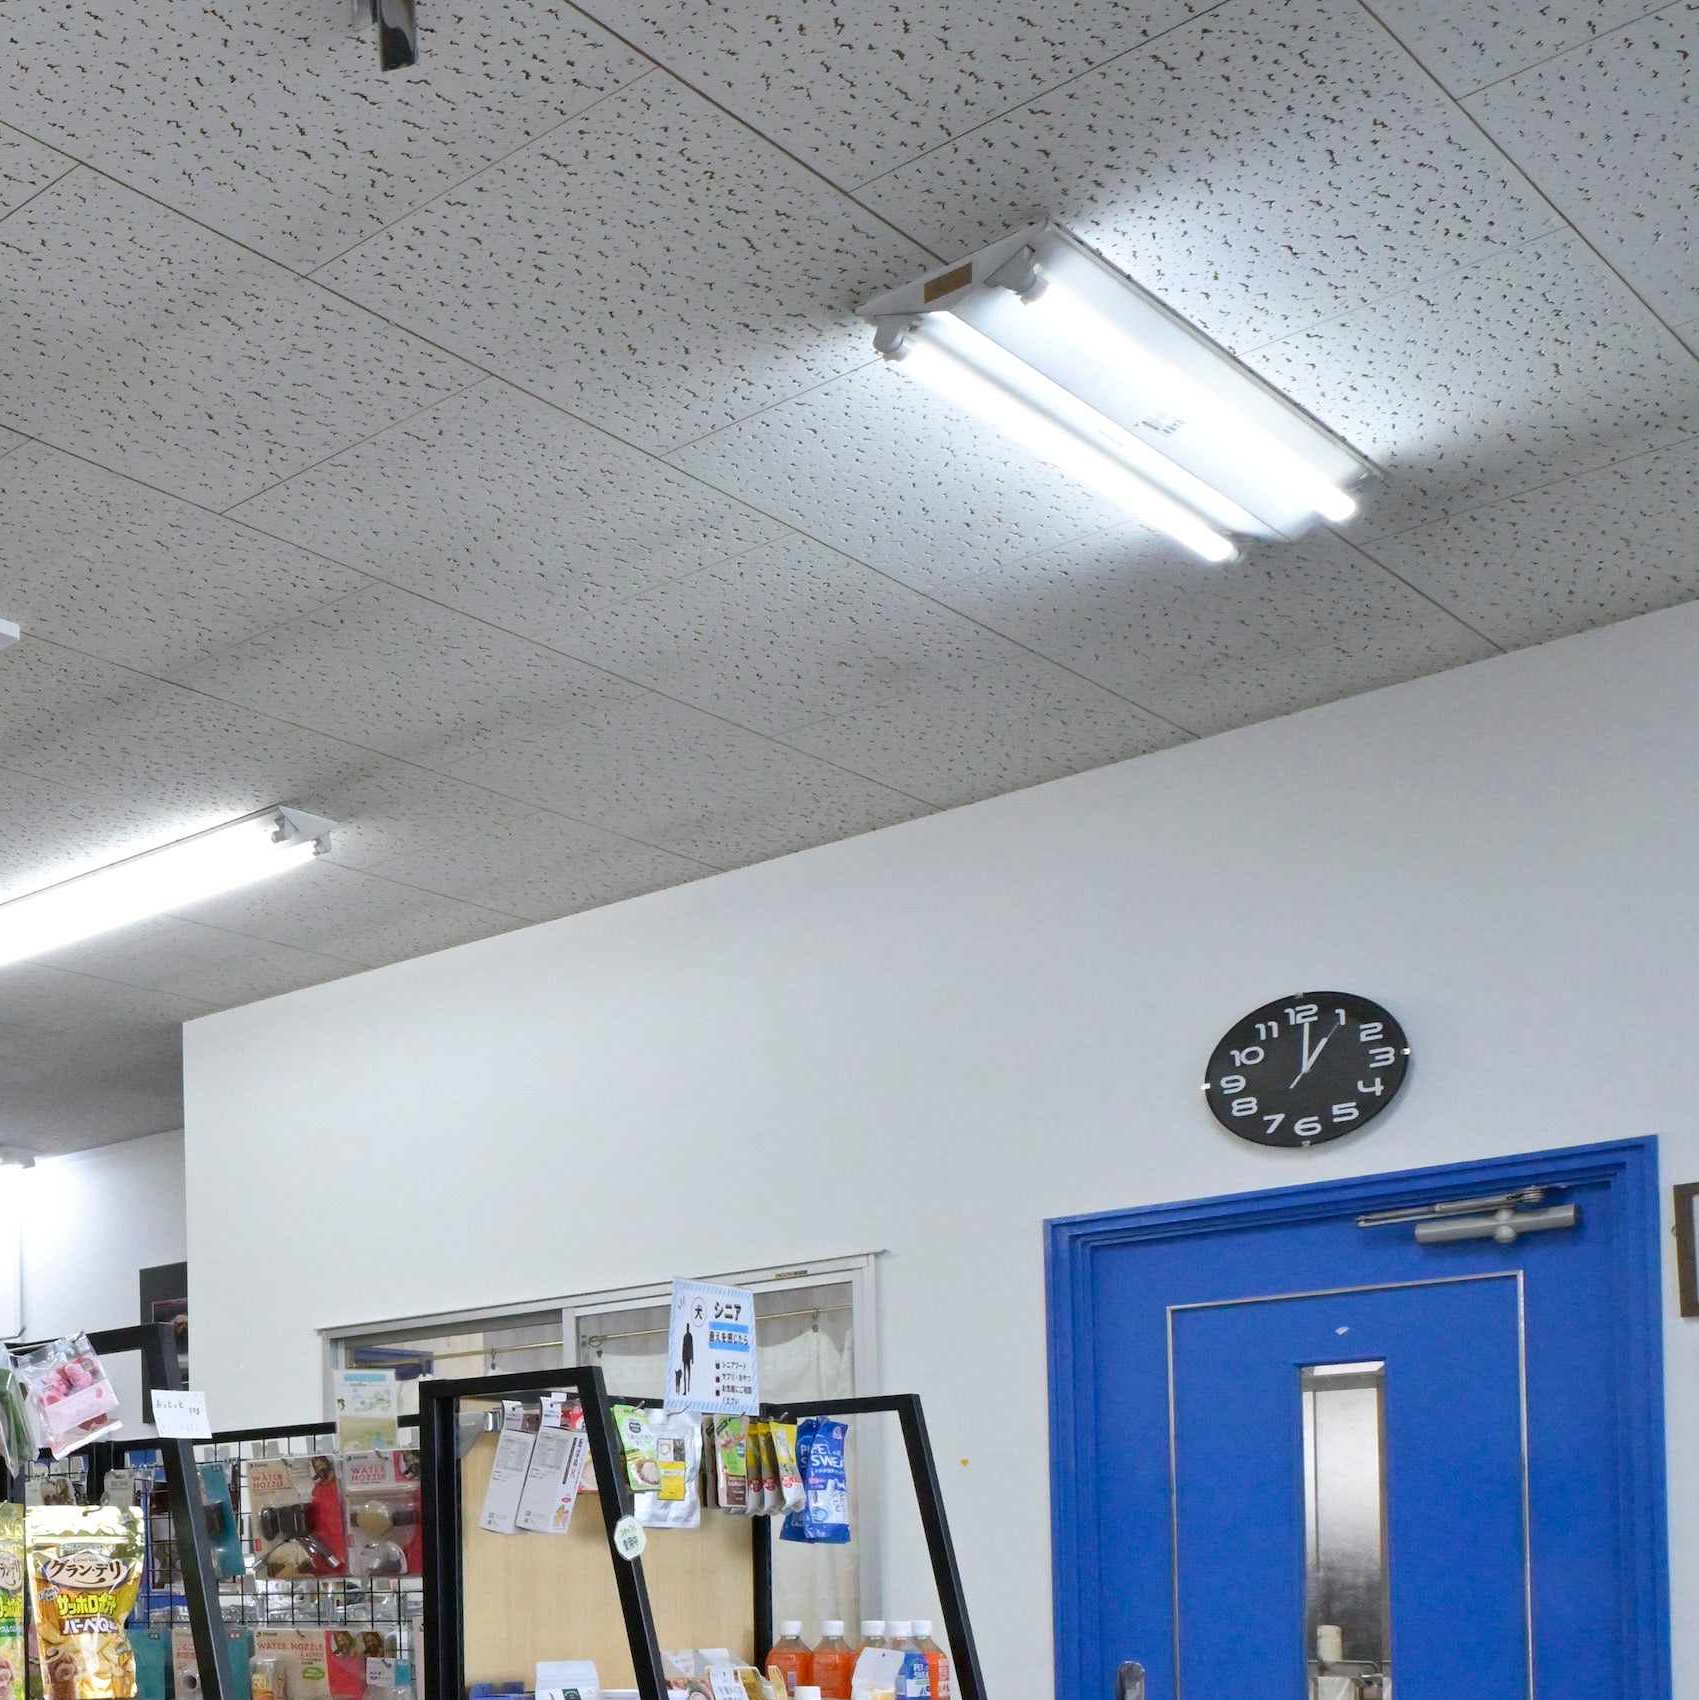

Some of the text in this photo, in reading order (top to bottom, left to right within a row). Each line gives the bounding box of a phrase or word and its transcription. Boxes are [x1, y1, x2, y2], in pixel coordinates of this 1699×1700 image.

[1284, 1003, 1319, 1026] 12
[1335, 1008, 1346, 1026] 1
[1255, 1021, 1279, 1041] 11
[1359, 1022, 1384, 1042] 2
[1230, 1046, 1265, 1067] 10
[1369, 1046, 1396, 1069] 3
[1220, 1074, 1246, 1095] 9
[1357, 1077, 1385, 1097] 4
[1231, 1096, 1258, 1117] 8
[1332, 1101, 1359, 1123] 5
[1263, 1113, 1286, 1134] 7
[1294, 1116, 1323, 1136] 6
[694, 1304, 703, 1321] 犬
[714, 1301, 742, 1321] シニア
[257, 1642, 325, 1651] WATER NOZZLE
